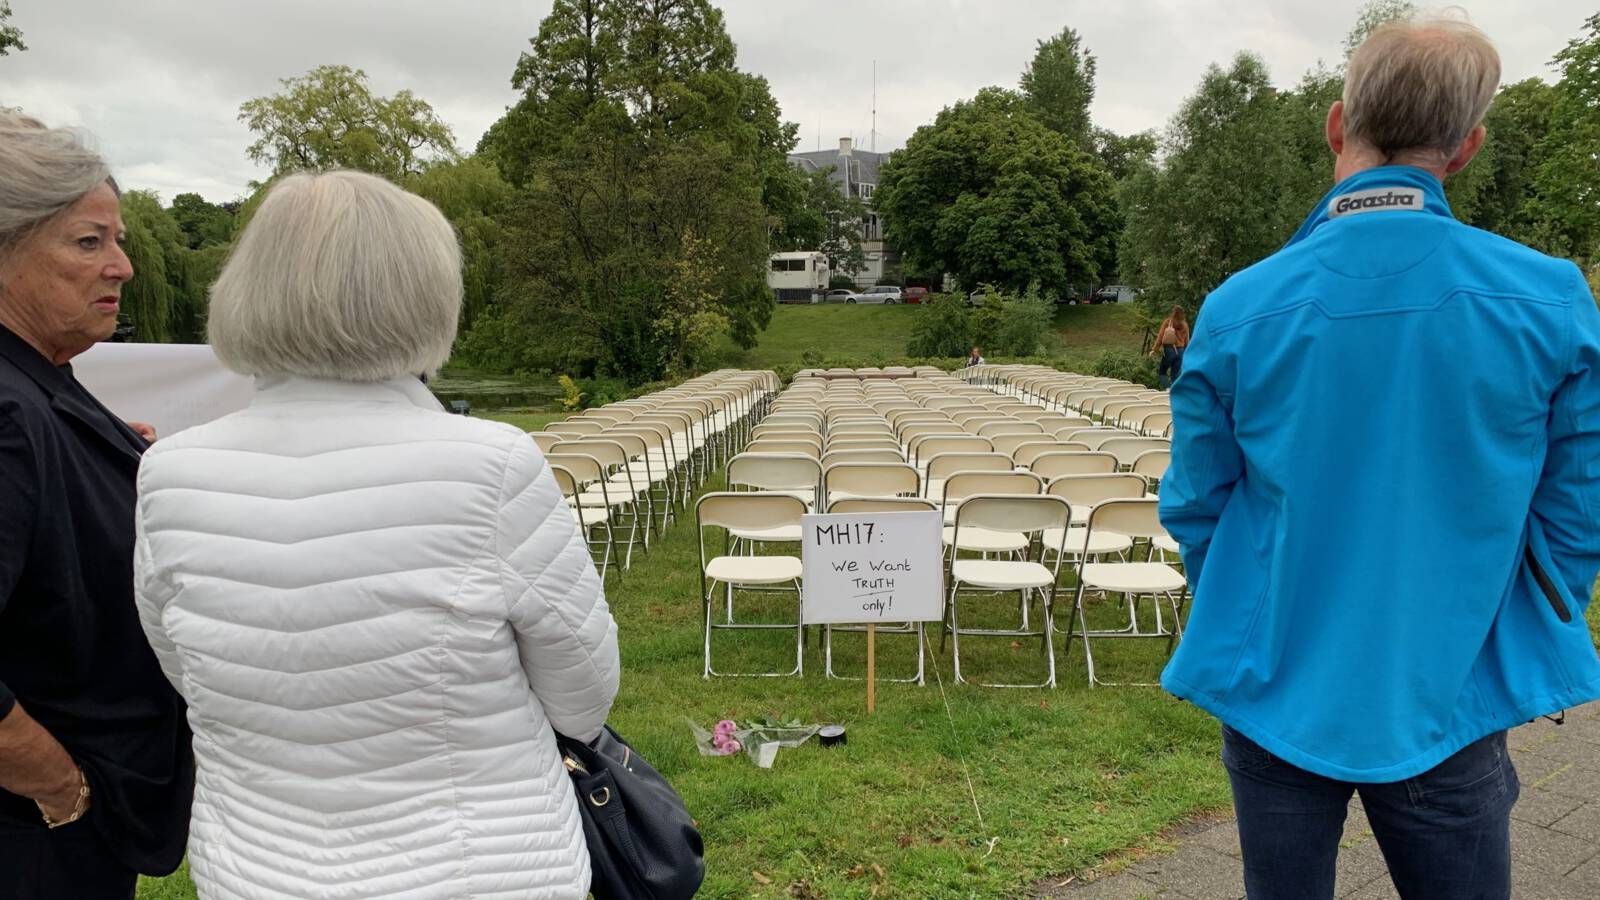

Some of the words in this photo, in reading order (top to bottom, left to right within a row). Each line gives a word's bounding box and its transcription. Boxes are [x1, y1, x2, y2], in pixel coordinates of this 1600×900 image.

[1336, 191, 1415, 213] Gaastra
[816, 522, 884, 546] MH17:
[851, 578, 895, 589] TRUTH
[862, 596, 893, 616] only!
